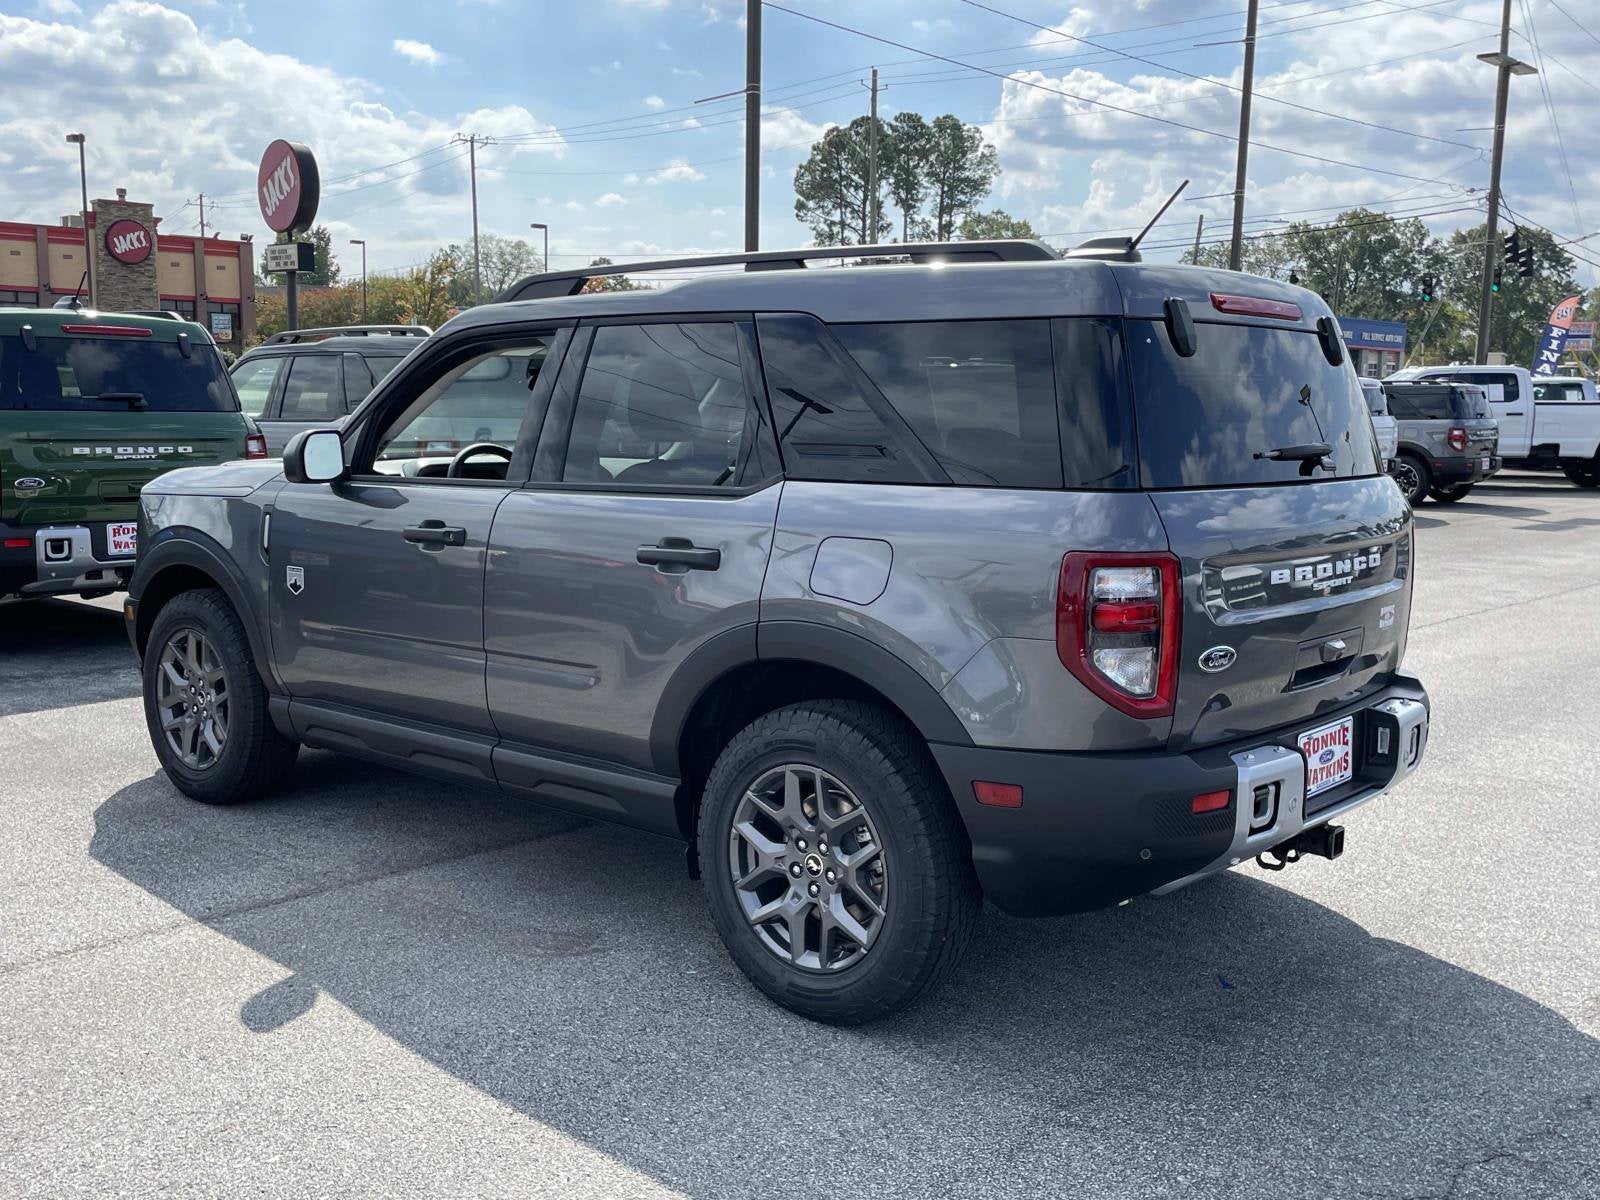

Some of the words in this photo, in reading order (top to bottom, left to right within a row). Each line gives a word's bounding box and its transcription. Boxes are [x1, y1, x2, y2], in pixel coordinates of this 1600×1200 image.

[1556, 305, 1575, 320] EASY
[1534, 326, 1567, 377] FINA
[72, 446, 193, 455] BRONCO
[1270, 553, 1381, 585] BRONCO
[1312, 576, 1353, 591] SPORT
[1206, 650, 1233, 668] Ford
[1303, 727, 1349, 758] RONNIE
